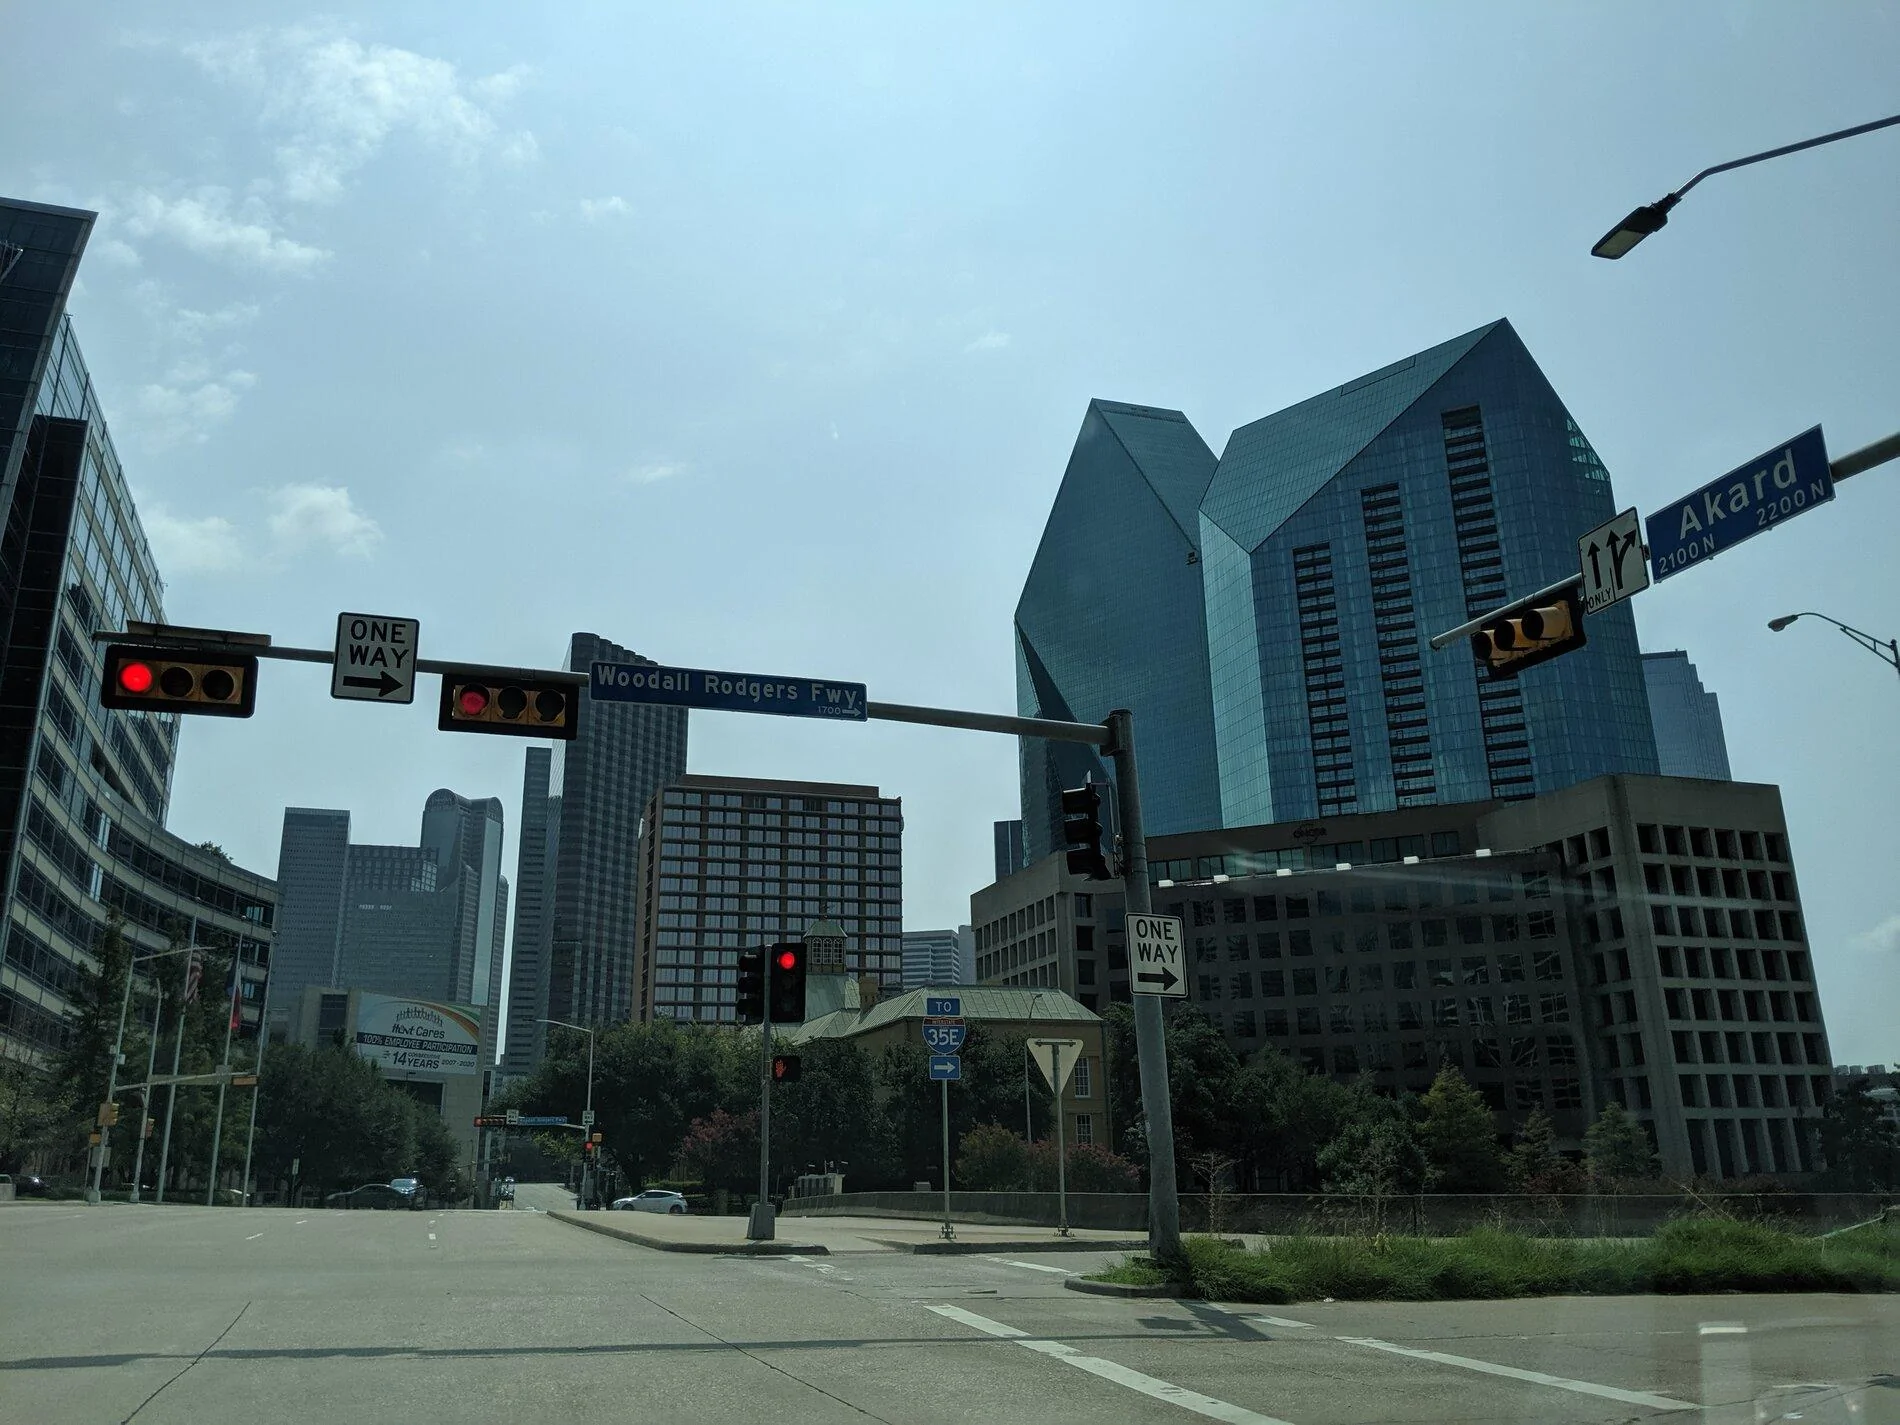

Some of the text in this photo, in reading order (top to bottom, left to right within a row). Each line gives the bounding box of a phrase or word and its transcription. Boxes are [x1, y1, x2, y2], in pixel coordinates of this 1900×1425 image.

[1679, 448, 1798, 541] Akard
[1756, 479, 1826, 527] 2200 N
[1658, 533, 1716, 575] 2100 N
[1588, 586, 1612, 609] ONLY
[350, 619, 406, 644] ONE
[349, 644, 409, 669] WAY
[597, 664, 690, 692] Woodall
[705, 674, 799, 703] Rodgers
[817, 705, 842, 716] 1700
[1136, 918, 1175, 941] ONE
[1137, 942, 1178, 964] WAY
[935, 1001, 952, 1013] TO
[416, 1025, 445, 1039] Cares
[927, 1028, 960, 1046] 35E
[363, 1034, 473, 1054] 100% EMPLOYEE PARTICIPATION
[392, 1051, 407, 1065] 14
[408, 1058, 440, 1069] YEARS
